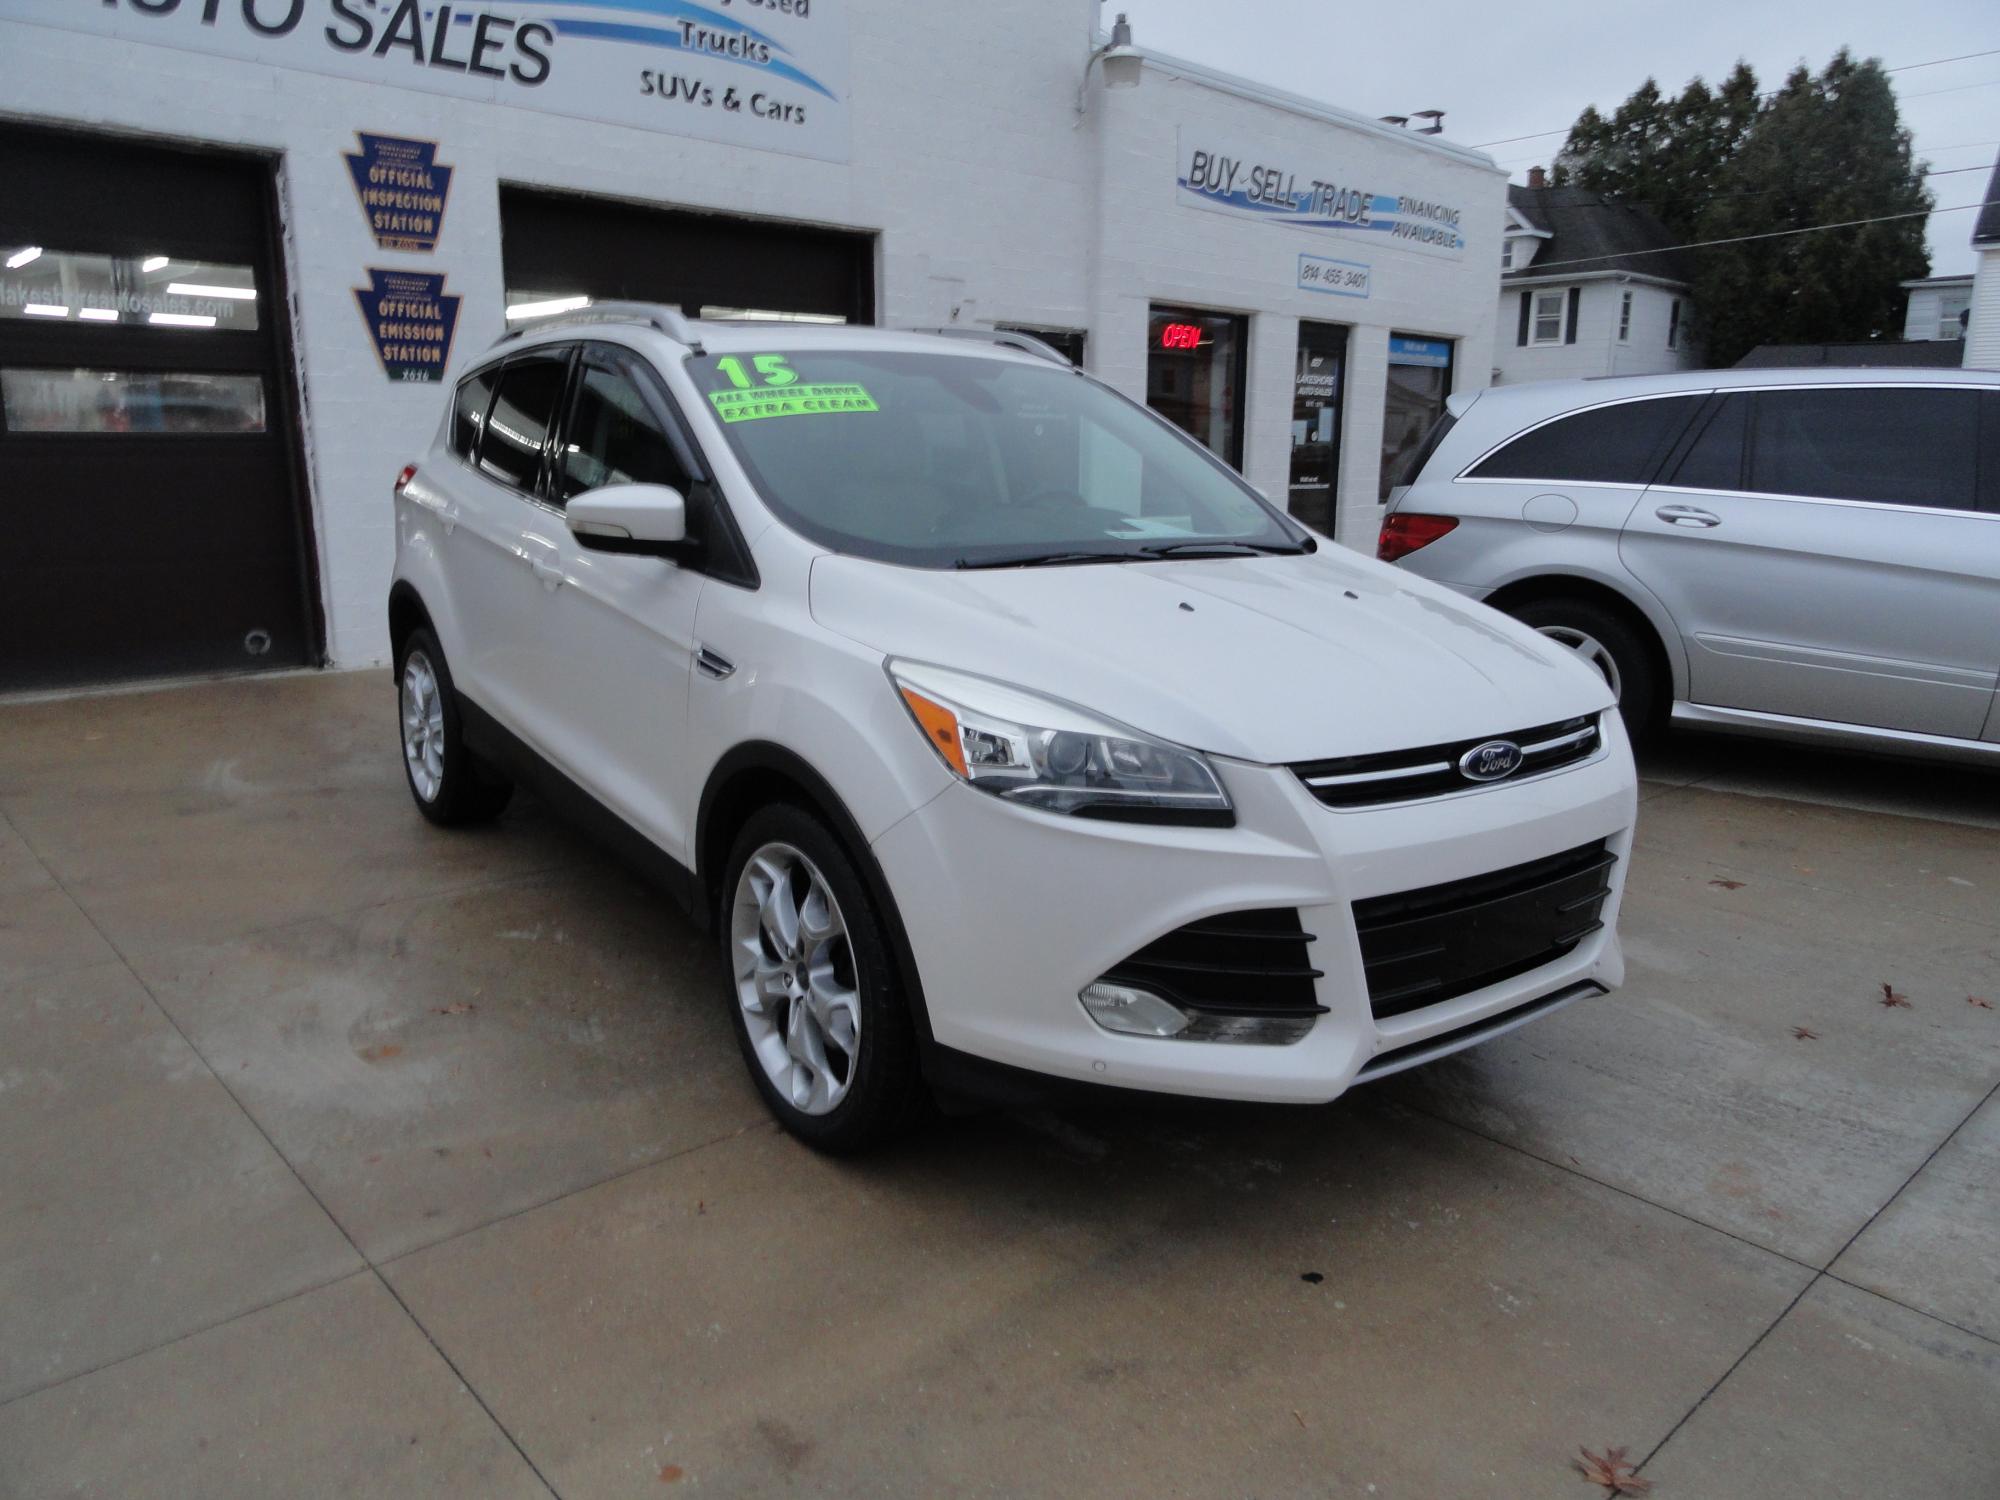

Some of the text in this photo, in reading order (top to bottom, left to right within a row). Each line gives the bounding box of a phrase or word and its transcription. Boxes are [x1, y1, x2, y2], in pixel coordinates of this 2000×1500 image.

[750, 0, 809, 19] sed
[324, 0, 553, 88] SALES
[677, 20, 769, 63] Trucks
[640, 70, 806, 125] SUVs & Cars
[369, 165, 433, 190] OFFICIAL
[1189, 150, 1375, 226] BUY SELL TRADE
[363, 187, 442, 213] INSPECTION
[1396, 196, 1461, 225] FINANCING
[374, 211, 433, 233] STATION
[1391, 222, 1458, 249] AVAILABLE
[1, 277, 234, 318] lakeshreautosales.com
[378, 300, 442, 320] OFFICIAL
[379, 321, 444, 342] EMISSION
[1162, 323, 1202, 349] OPEN
[383, 343, 440, 363] STATION
[716, 354, 799, 389] 15
[715, 386, 861, 404] ALL WHEEL DRIVE
[723, 399, 872, 420] EXTRA CLEAN
[1480, 746, 1513, 773] Ford
